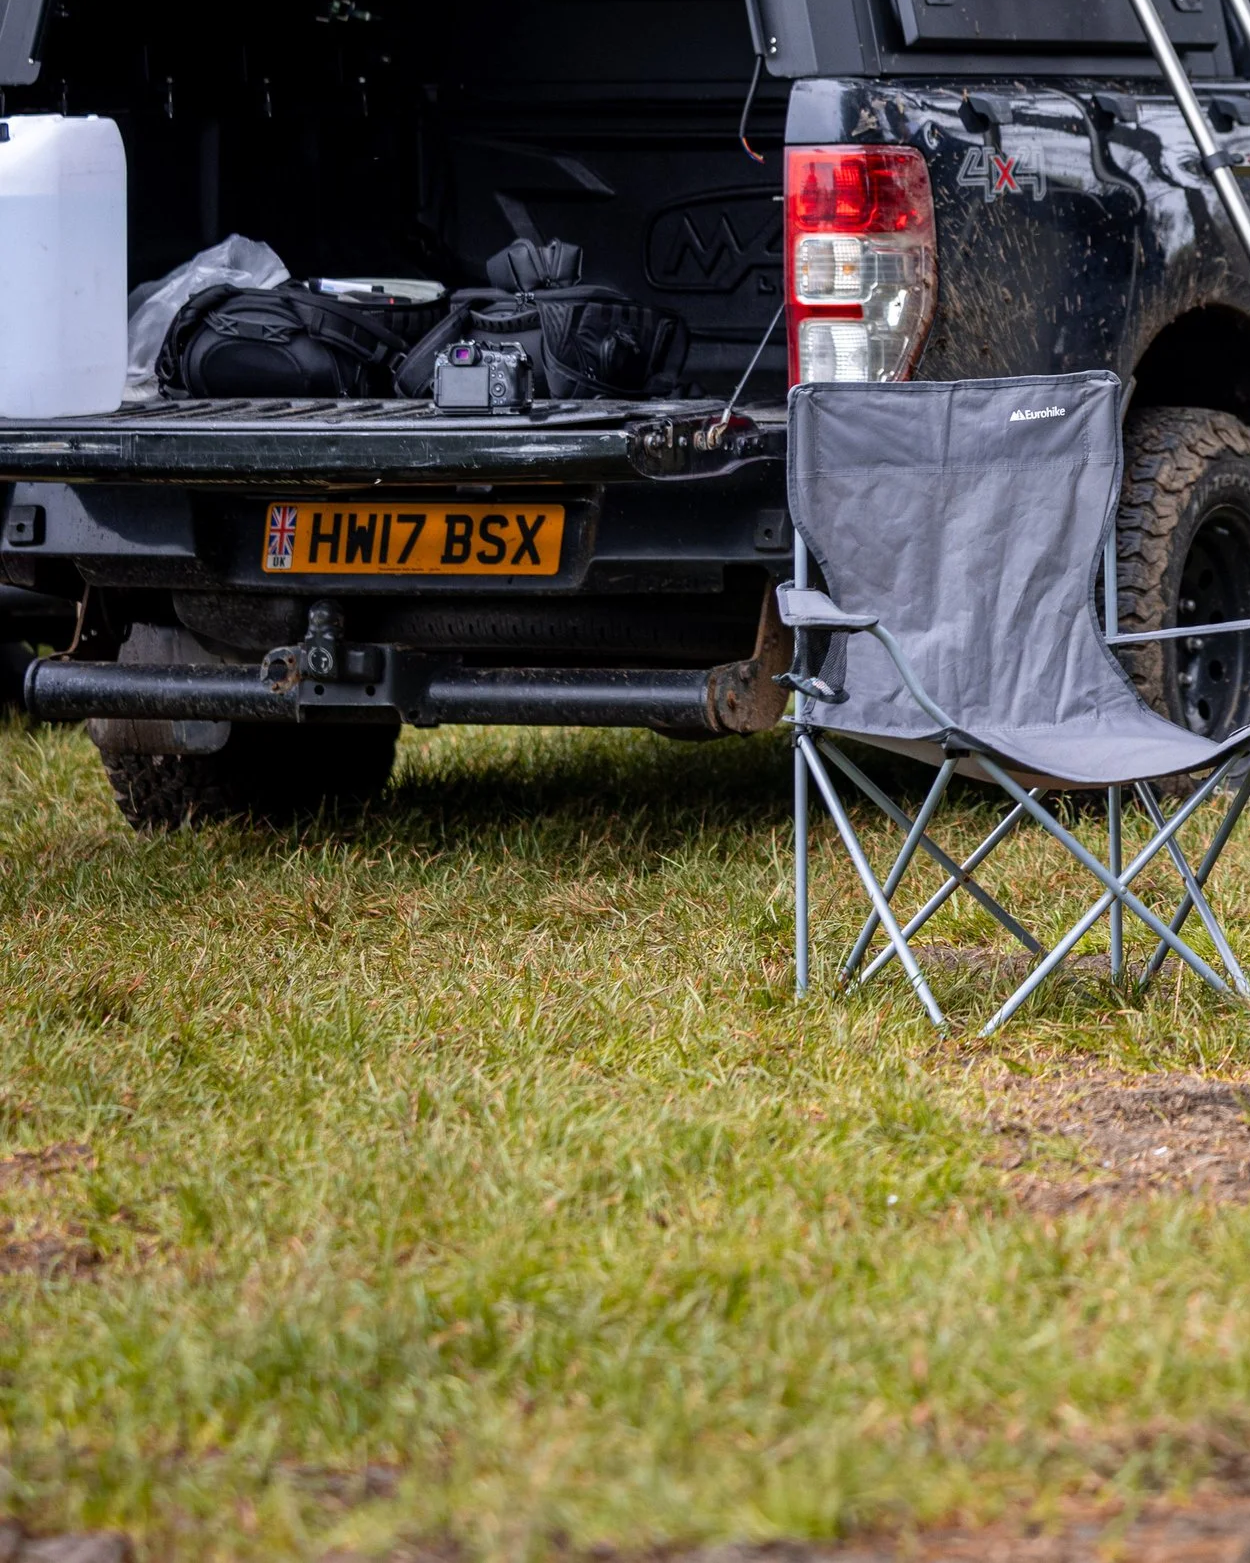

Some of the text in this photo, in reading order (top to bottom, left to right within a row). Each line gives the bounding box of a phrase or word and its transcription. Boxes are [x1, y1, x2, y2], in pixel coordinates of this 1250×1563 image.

[1025, 406, 1066, 419] Eurohike
[308, 512, 546, 565] HW17 BSX
[272, 554, 286, 568] UK
